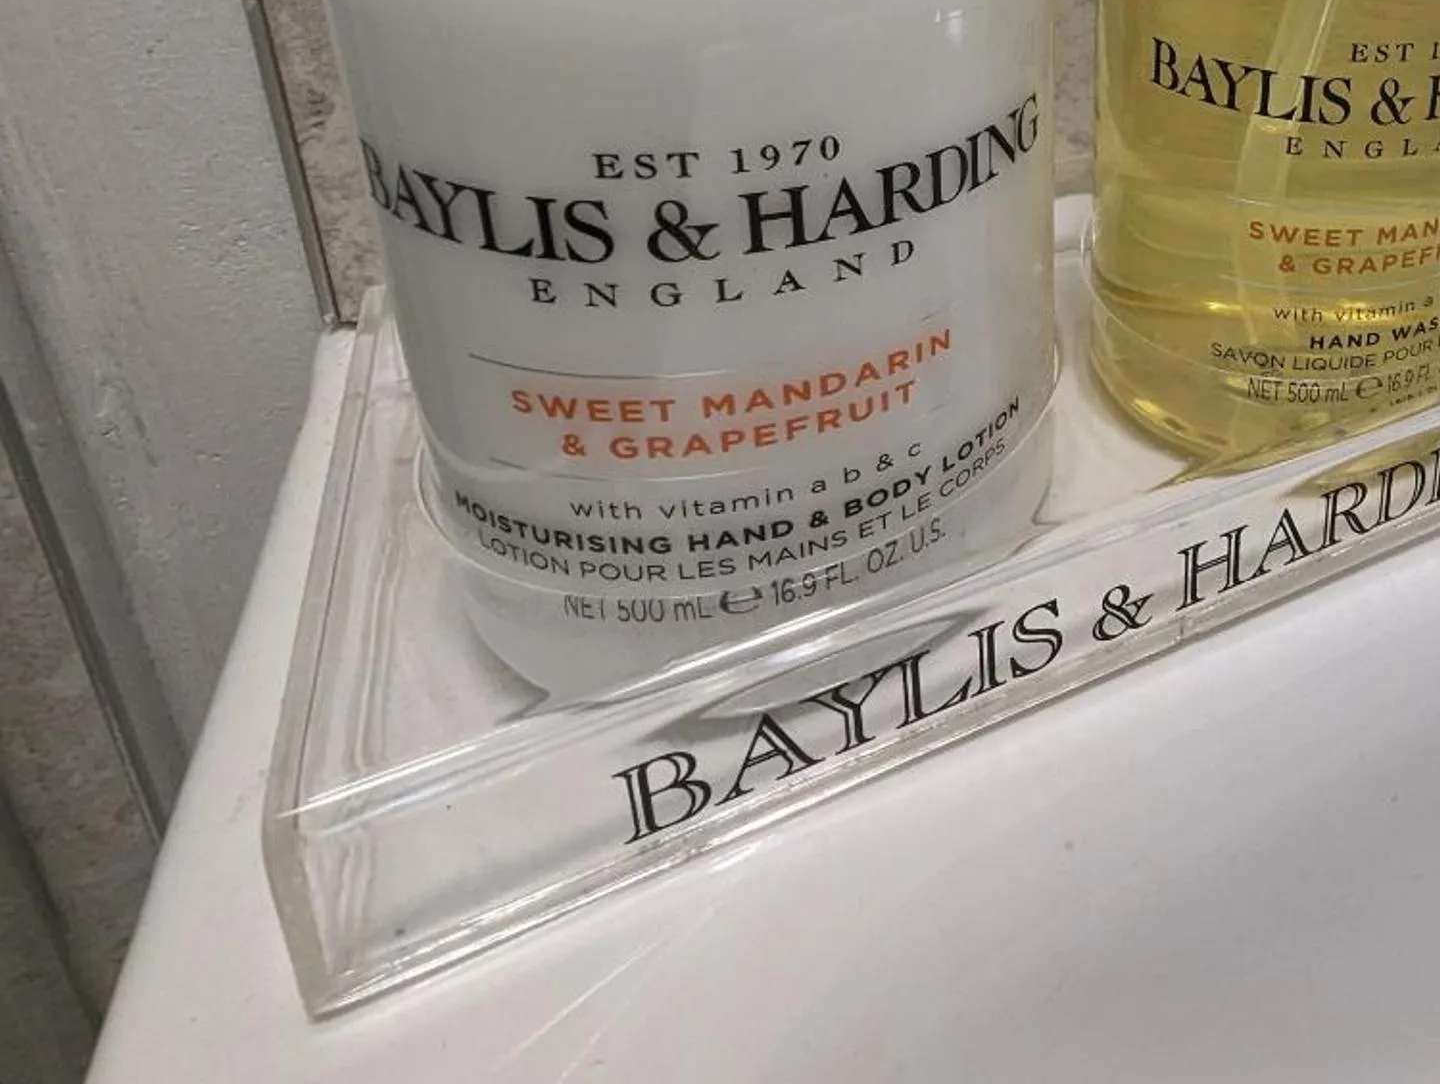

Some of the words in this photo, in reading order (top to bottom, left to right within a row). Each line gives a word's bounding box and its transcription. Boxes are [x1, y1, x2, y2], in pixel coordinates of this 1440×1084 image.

[1151, 36, 1352, 126] BAYLIS
[1370, 76, 1416, 126] &
[1350, 41, 1415, 64] EST
[358, 135, 615, 264] BAYLIS
[647, 199, 721, 264] &
[738, 92, 1040, 256] HARDING
[593, 152, 700, 180] EST
[730, 134, 841, 175] 1970
[1249, 220, 1364, 248] SWEET
[530, 239, 915, 307] ENGLAND
[1278, 254, 1297, 275] &
[1274, 306, 1323, 323] with
[1334, 299, 1416, 323] vitamin
[1210, 341, 1286, 370] SAVON
[1292, 352, 1377, 372] LIQUIDE
[1382, 339, 1434, 364] POUR
[1309, 331, 1380, 351] HAND
[510, 389, 676, 423] SWEET
[702, 329, 952, 419] MANDARIN
[1248, 376, 1283, 402] NET
[1287, 381, 1321, 404] 500
[1324, 380, 1350, 403] mL
[562, 434, 587, 458] &
[609, 379, 917, 460] GRAPEFRUIT
[455, 489, 672, 555] MOISTURISING
[688, 519, 794, 553] HAND
[809, 511, 830, 530] &
[844, 465, 932, 519] BODY
[942, 395, 1020, 473] LOTION
[570, 499, 642, 520] with
[659, 484, 794, 518] vitamin
[810, 479, 828, 495] a
[844, 466, 861, 485] b
[877, 452, 894, 473] &
[907, 442, 922, 458] c
[478, 529, 570, 576] LOTION
[580, 561, 669, 582] POUR
[679, 557, 737, 580] LES
[748, 530, 848, 572] MAINS
[858, 511, 893, 540] ET
[902, 490, 933, 521] LE
[939, 437, 1007, 498] CORPS
[771, 569, 817, 606] 16.9
[613, 598, 1065, 846] BAYLIS
[1091, 583, 1154, 644] &
